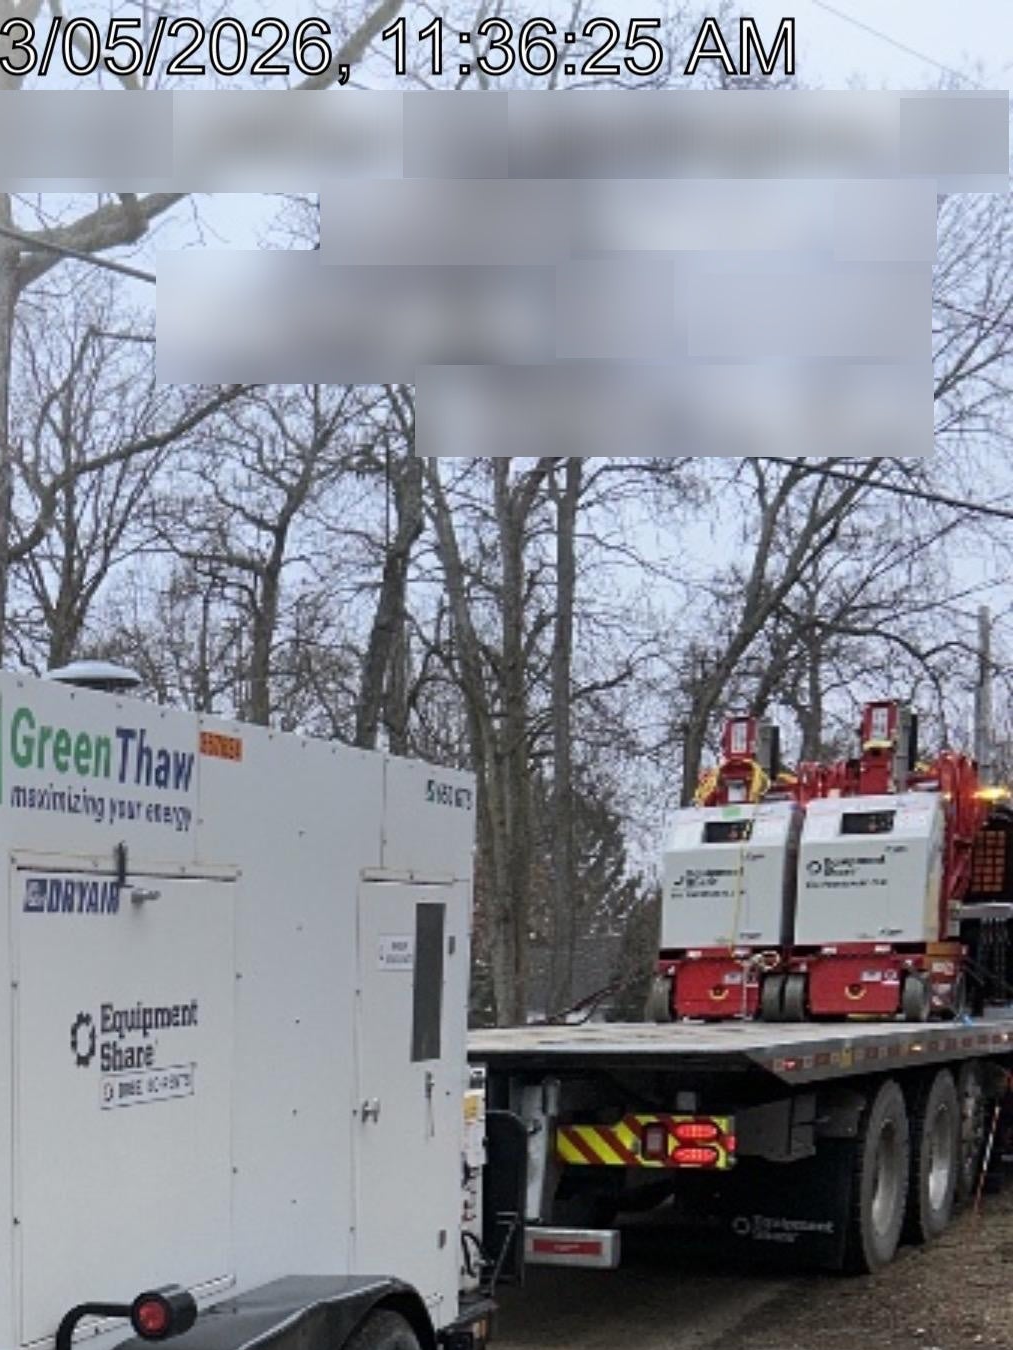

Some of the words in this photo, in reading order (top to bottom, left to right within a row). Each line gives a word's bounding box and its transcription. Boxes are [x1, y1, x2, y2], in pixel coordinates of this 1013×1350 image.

[10, 707, 194, 792] GreenThaw
[11, 783, 105, 824] maximizing
[109, 797, 143, 825] your
[145, 803, 192, 832] energy
[47, 879, 121, 914] DRYAIR
[100, 999, 198, 1039] Equipment
[100, 1041, 154, 1072] Share
